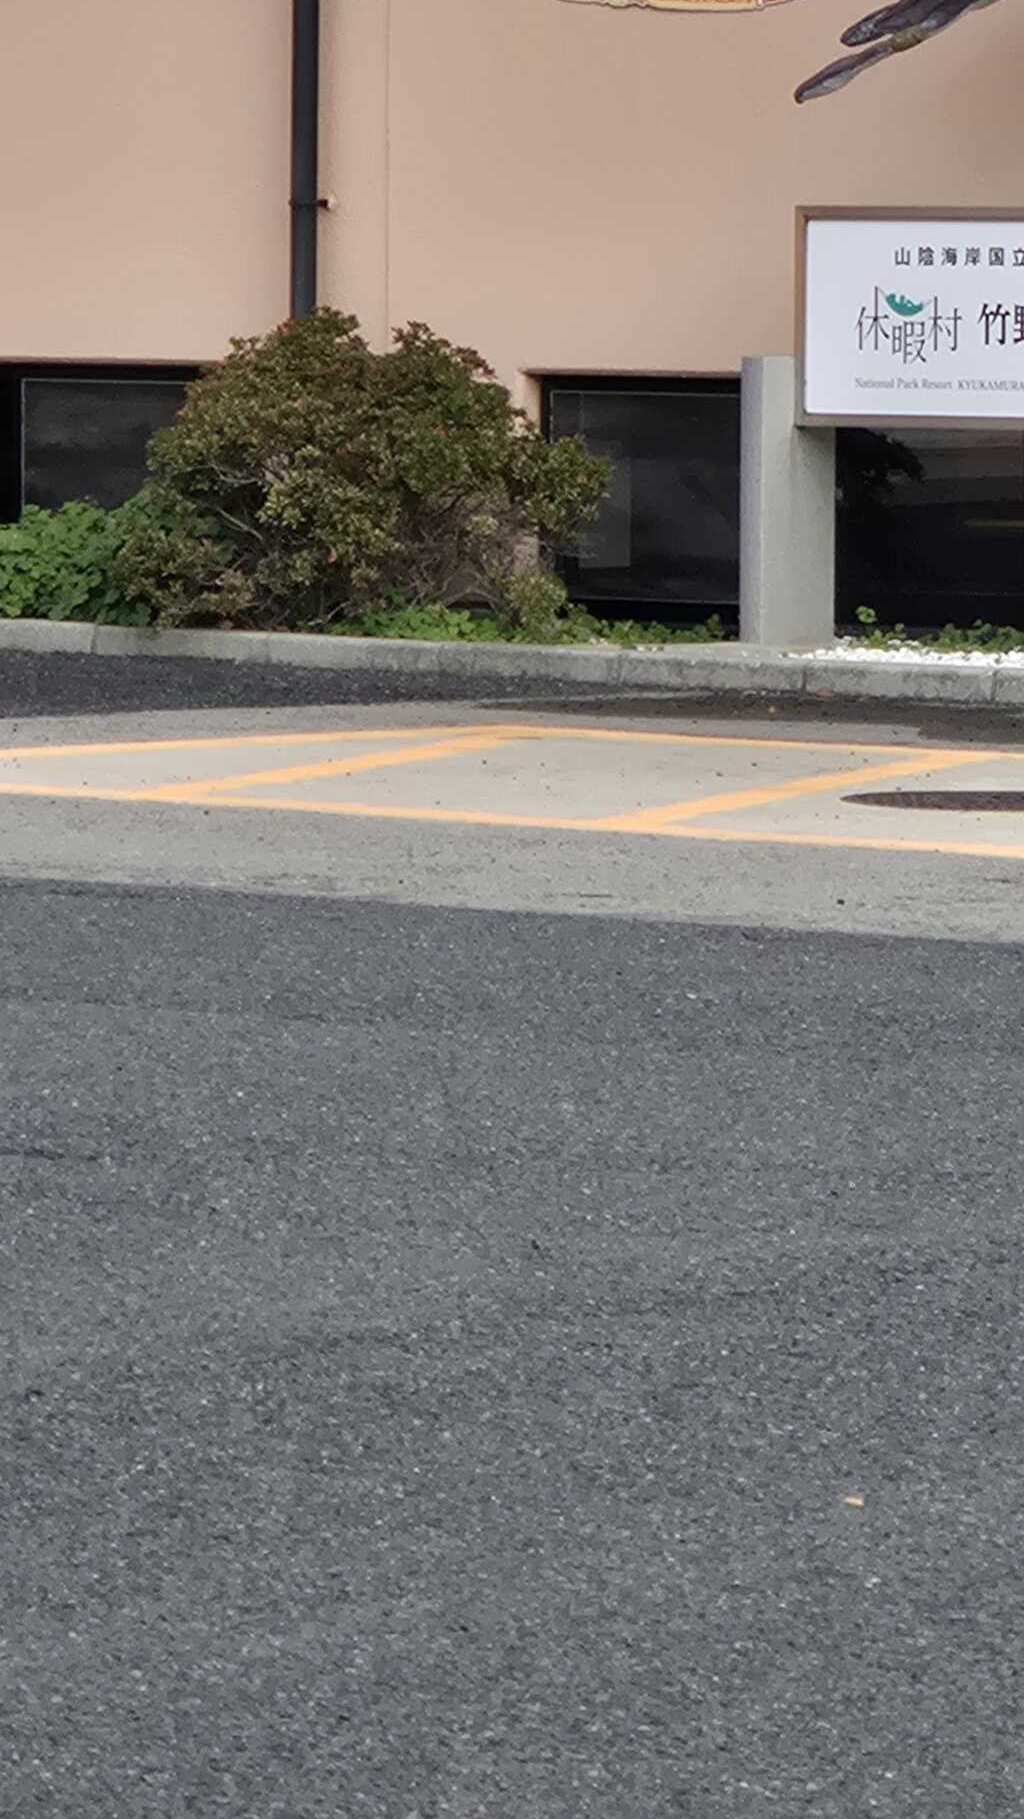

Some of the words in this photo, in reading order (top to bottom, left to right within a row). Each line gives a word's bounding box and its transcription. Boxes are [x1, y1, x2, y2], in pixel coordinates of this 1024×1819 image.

[855, 286, 962, 364] 休暇村
[855, 377, 895, 389] National
[897, 378, 919, 389] Park
[921, 378, 953, 389] Resort
[958, 379, 1024, 391] KYUKAMURA
